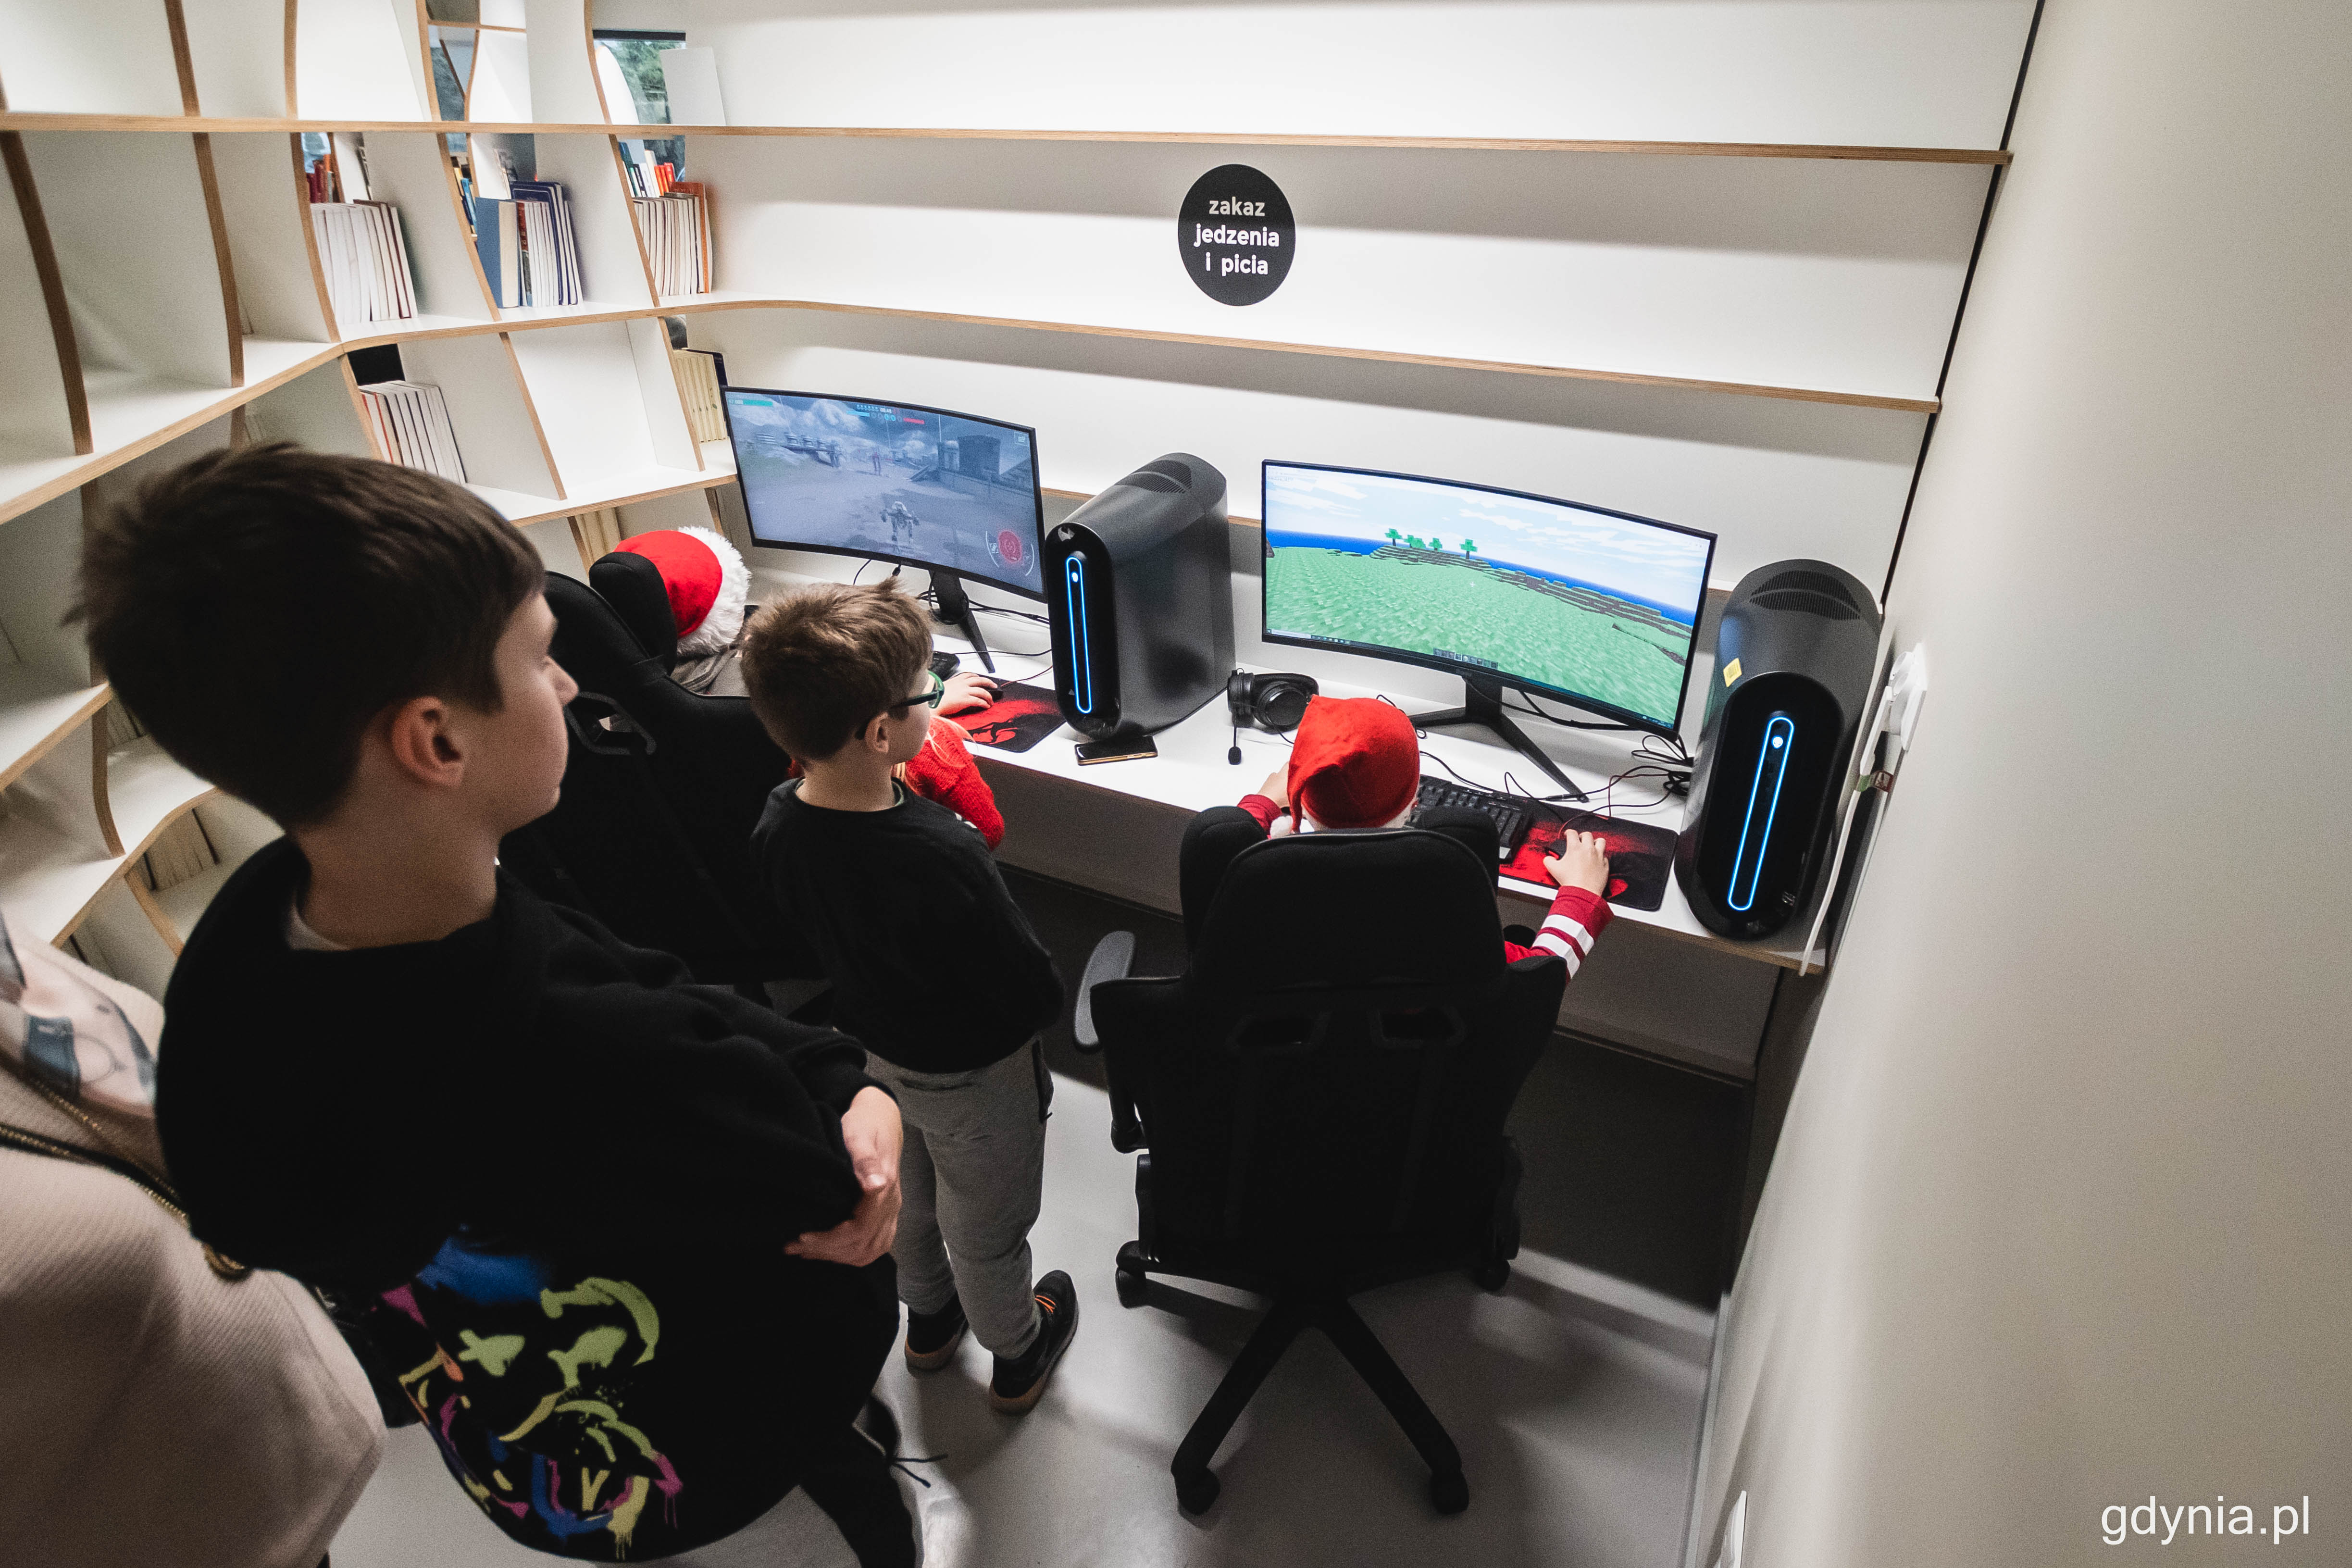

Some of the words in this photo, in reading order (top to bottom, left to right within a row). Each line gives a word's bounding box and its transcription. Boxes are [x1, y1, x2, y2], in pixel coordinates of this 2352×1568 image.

[1209, 196, 1265, 216] zakaz
[1194, 223, 1280, 247] jedzenia
[1206, 251, 1211, 271] i
[1221, 253, 1268, 276] picia
